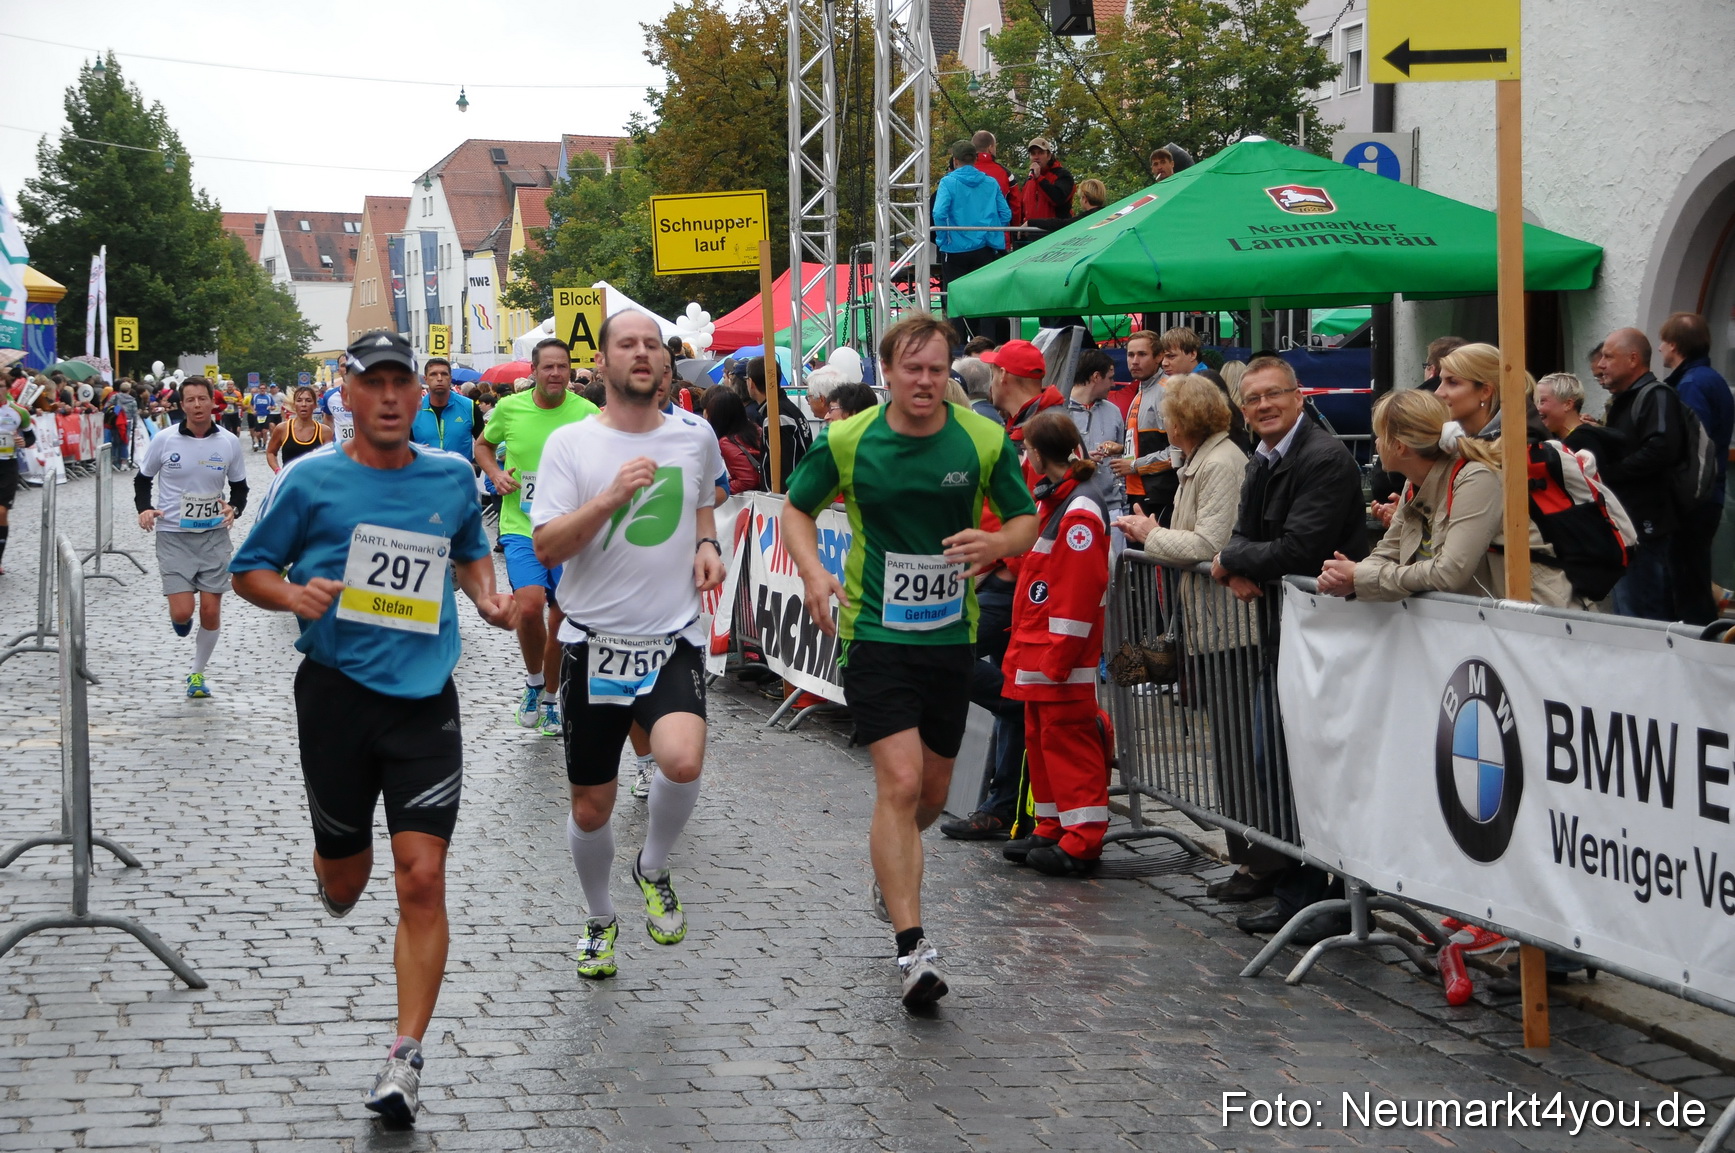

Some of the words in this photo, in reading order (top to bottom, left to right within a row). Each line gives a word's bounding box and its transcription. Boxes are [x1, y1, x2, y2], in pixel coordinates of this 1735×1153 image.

[660, 216, 758, 233] Schnupper-
[1247, 220, 1397, 235] Neumarkter
[694, 236, 726, 253] lauf
[1226, 232, 1438, 252] Lammsbräu
[560, 291, 600, 306] Block
[121, 327, 133, 343] B
[567, 312, 597, 350] A
[434, 335, 445, 350] B
[342, 428, 354, 439] 30
[941, 471, 969, 485] AOK
[525, 482, 536, 500] 2
[185, 501, 220, 518] 2754
[354, 533, 388, 547] PARTL
[390, 539, 435, 555] Neumarkt
[366, 551, 431, 593] 297
[887, 560, 916, 570] PARTL
[893, 570, 959, 602] 2948
[372, 596, 413, 616] Stefan
[904, 606, 947, 620] Gerhard
[590, 636, 619, 645] PARTL
[620, 638, 662, 647] Neumarkt
[1443, 663, 1515, 734] BMW
[1543, 698, 1679, 809] BMW
[1548, 808, 1688, 903] Weniger
